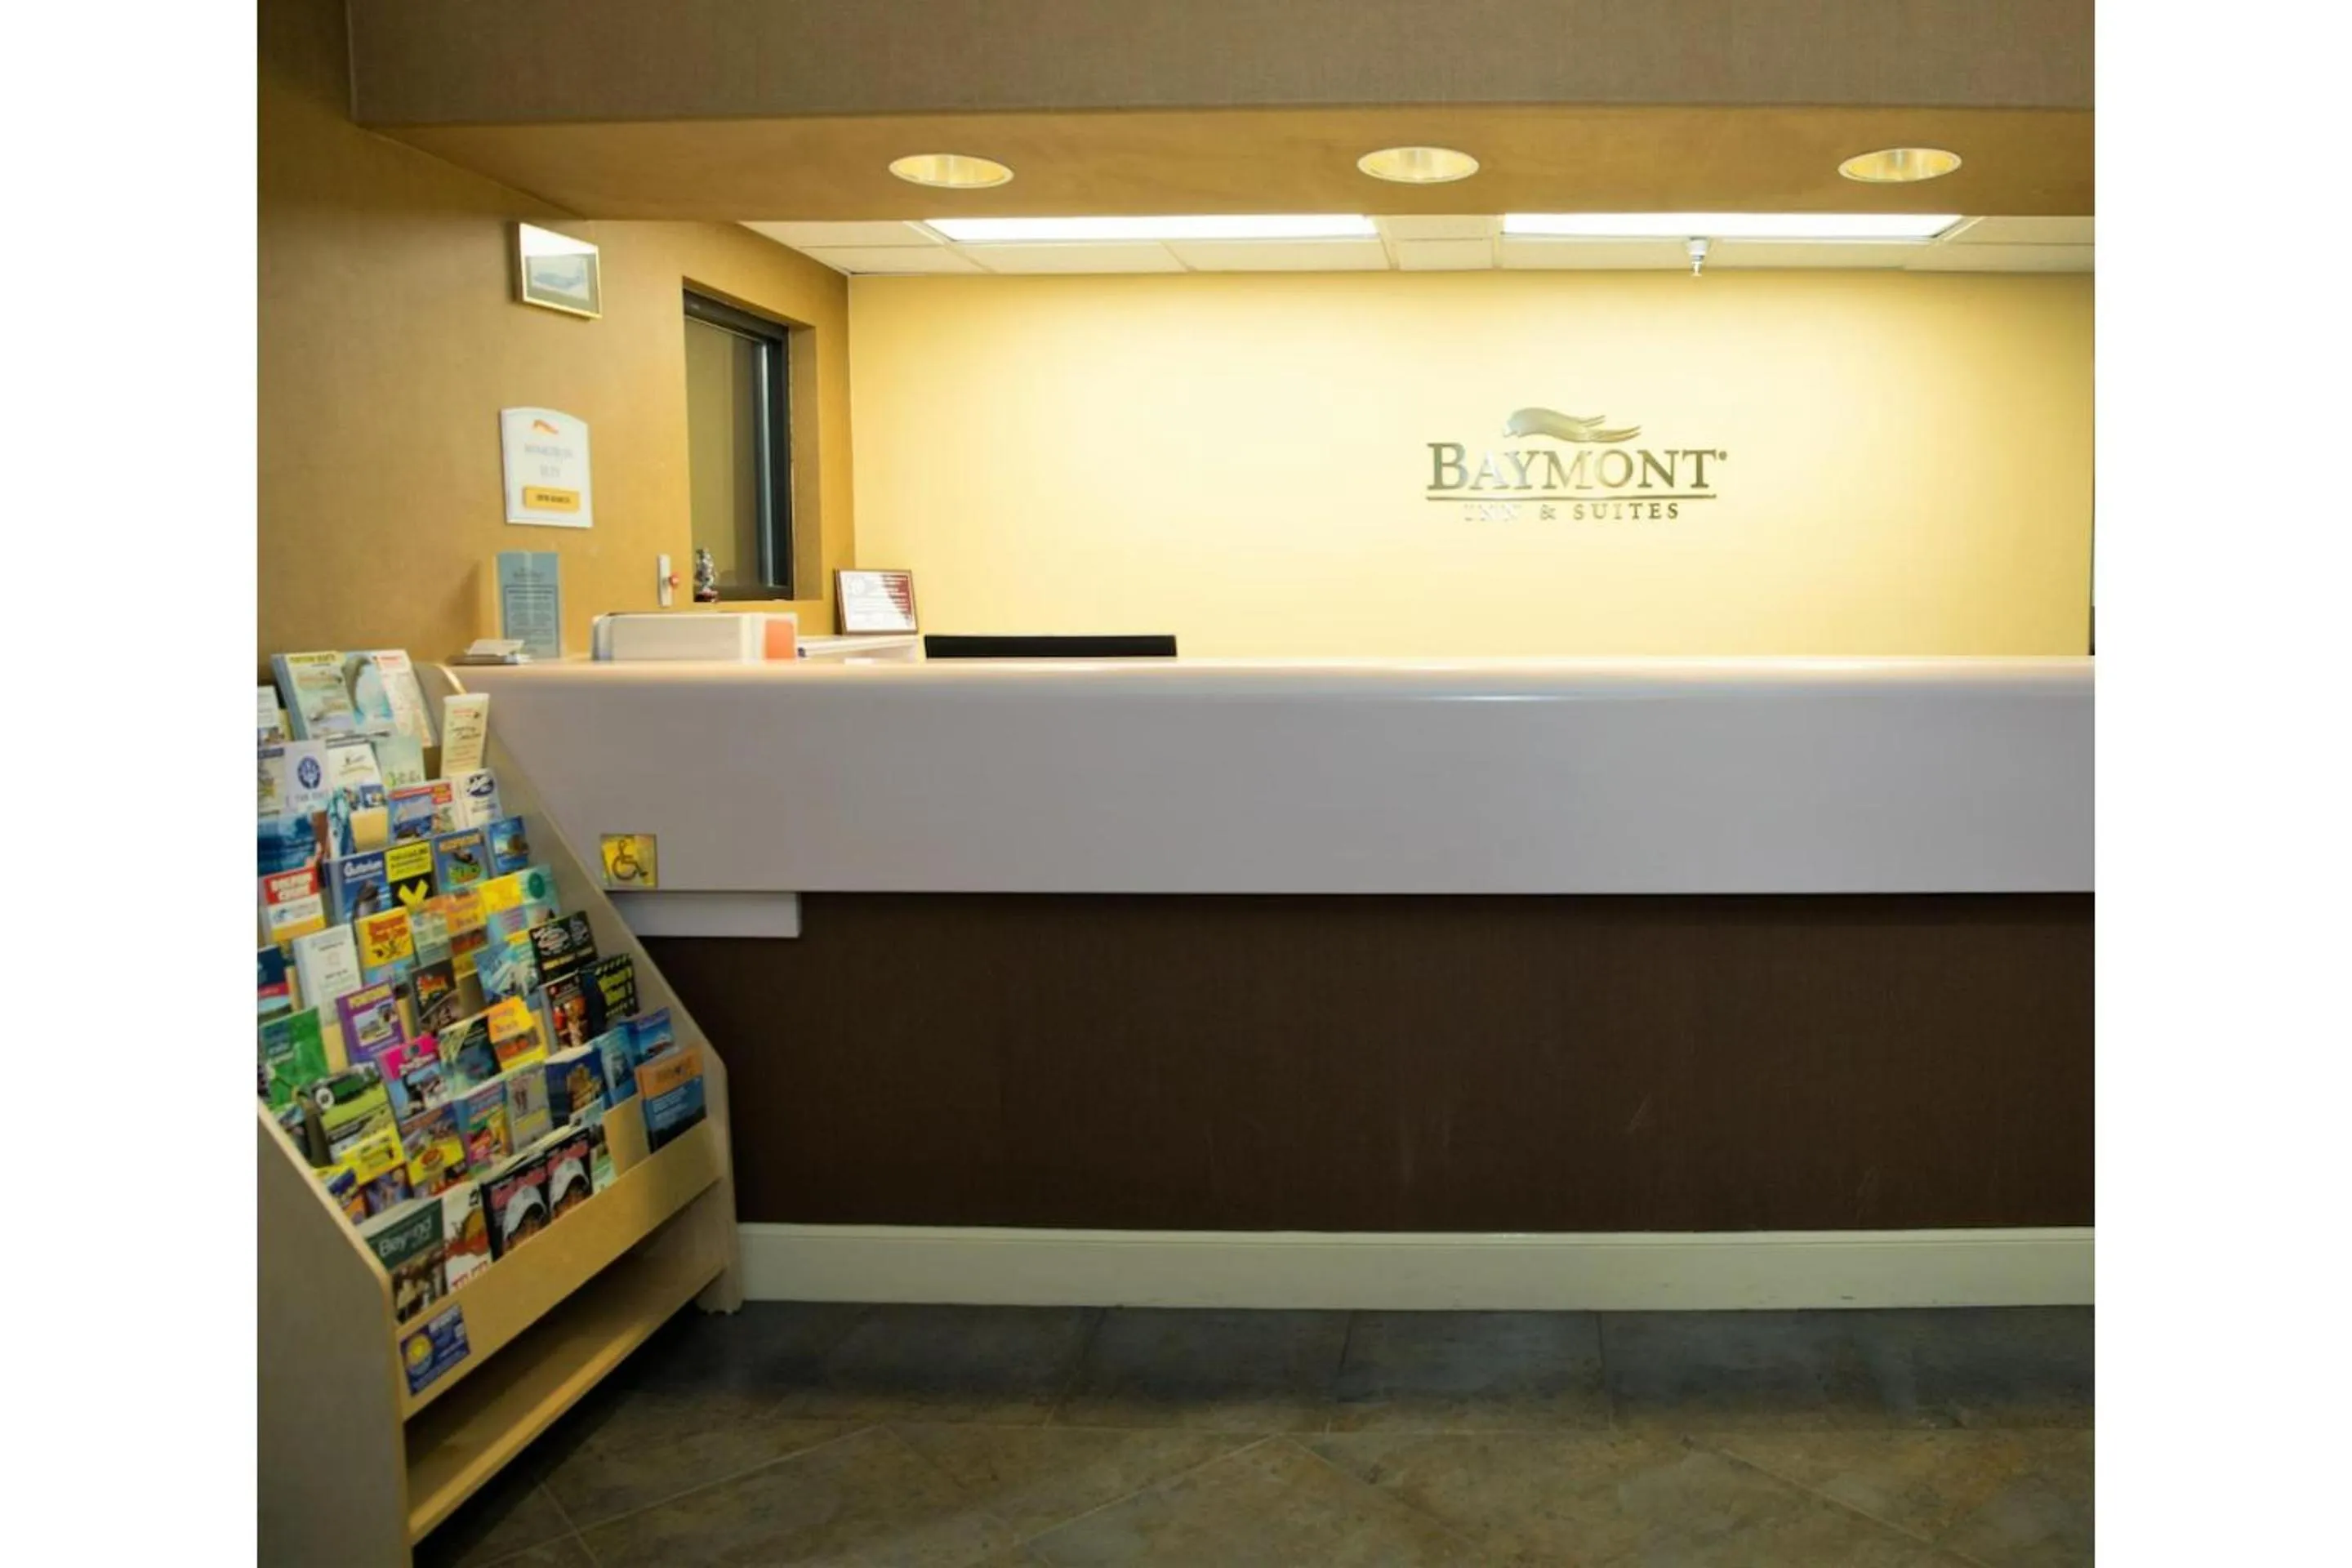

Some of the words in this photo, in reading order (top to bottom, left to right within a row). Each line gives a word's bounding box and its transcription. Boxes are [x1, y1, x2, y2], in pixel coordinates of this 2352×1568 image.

[1427, 442, 1717, 490] BAYMONT
[1539, 504, 1556, 519] &
[1573, 503, 1679, 520] SUITES
